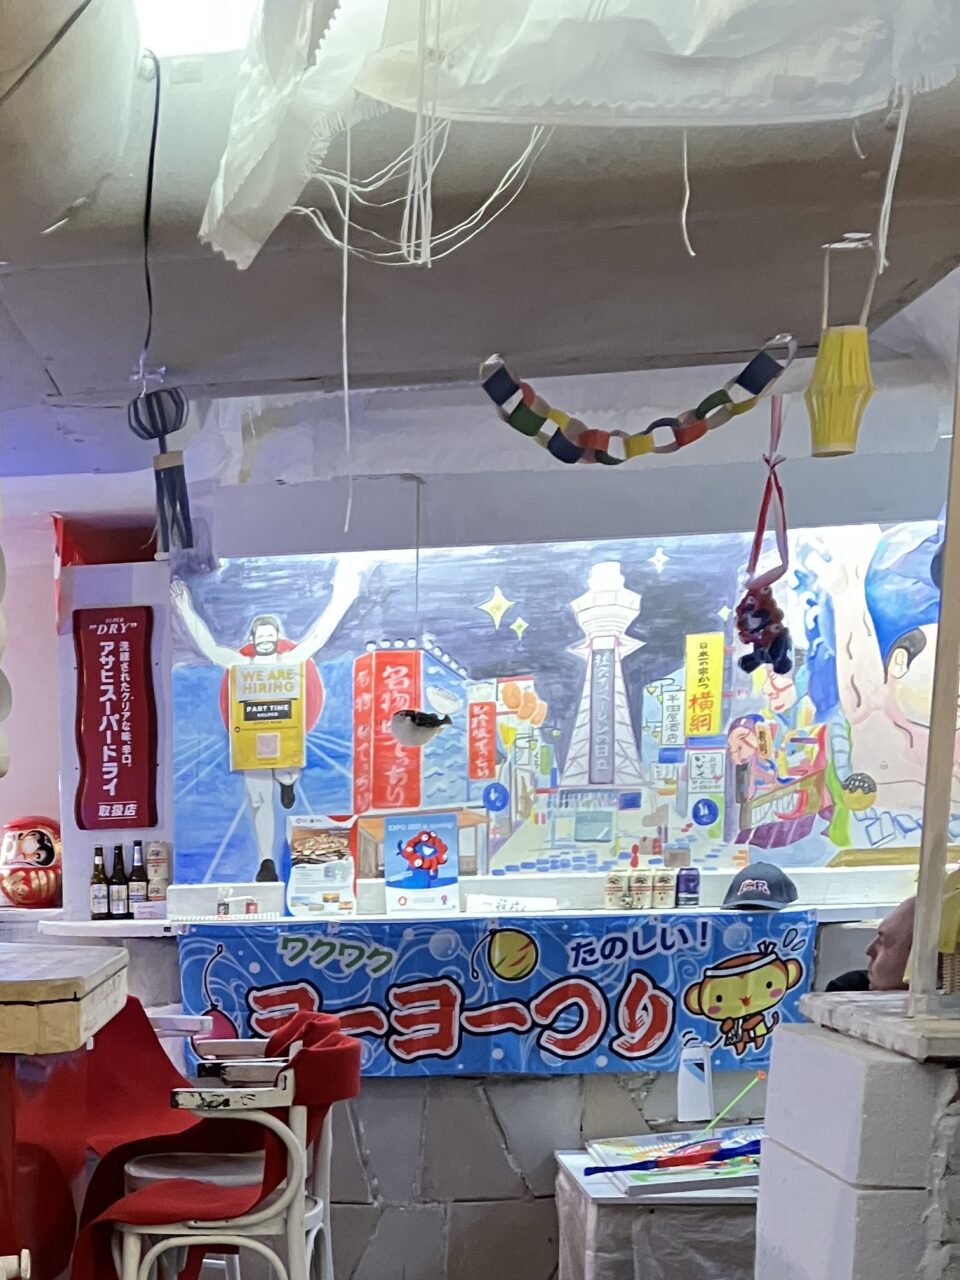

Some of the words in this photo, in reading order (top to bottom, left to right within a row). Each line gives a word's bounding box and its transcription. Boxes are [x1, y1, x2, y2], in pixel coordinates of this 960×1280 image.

[242, 670, 264, 681] WE
[268, 668, 294, 680] ARE
[242, 681, 295, 694] HIRING
[98, 641, 119, 796] アサヒスーパードライ
[688, 691, 715, 732] 横綱
[98, 803, 138, 817] 取扱店
[279, 936, 394, 975] ワクワク
[247, 972, 673, 1060] ヨーヨーつり
